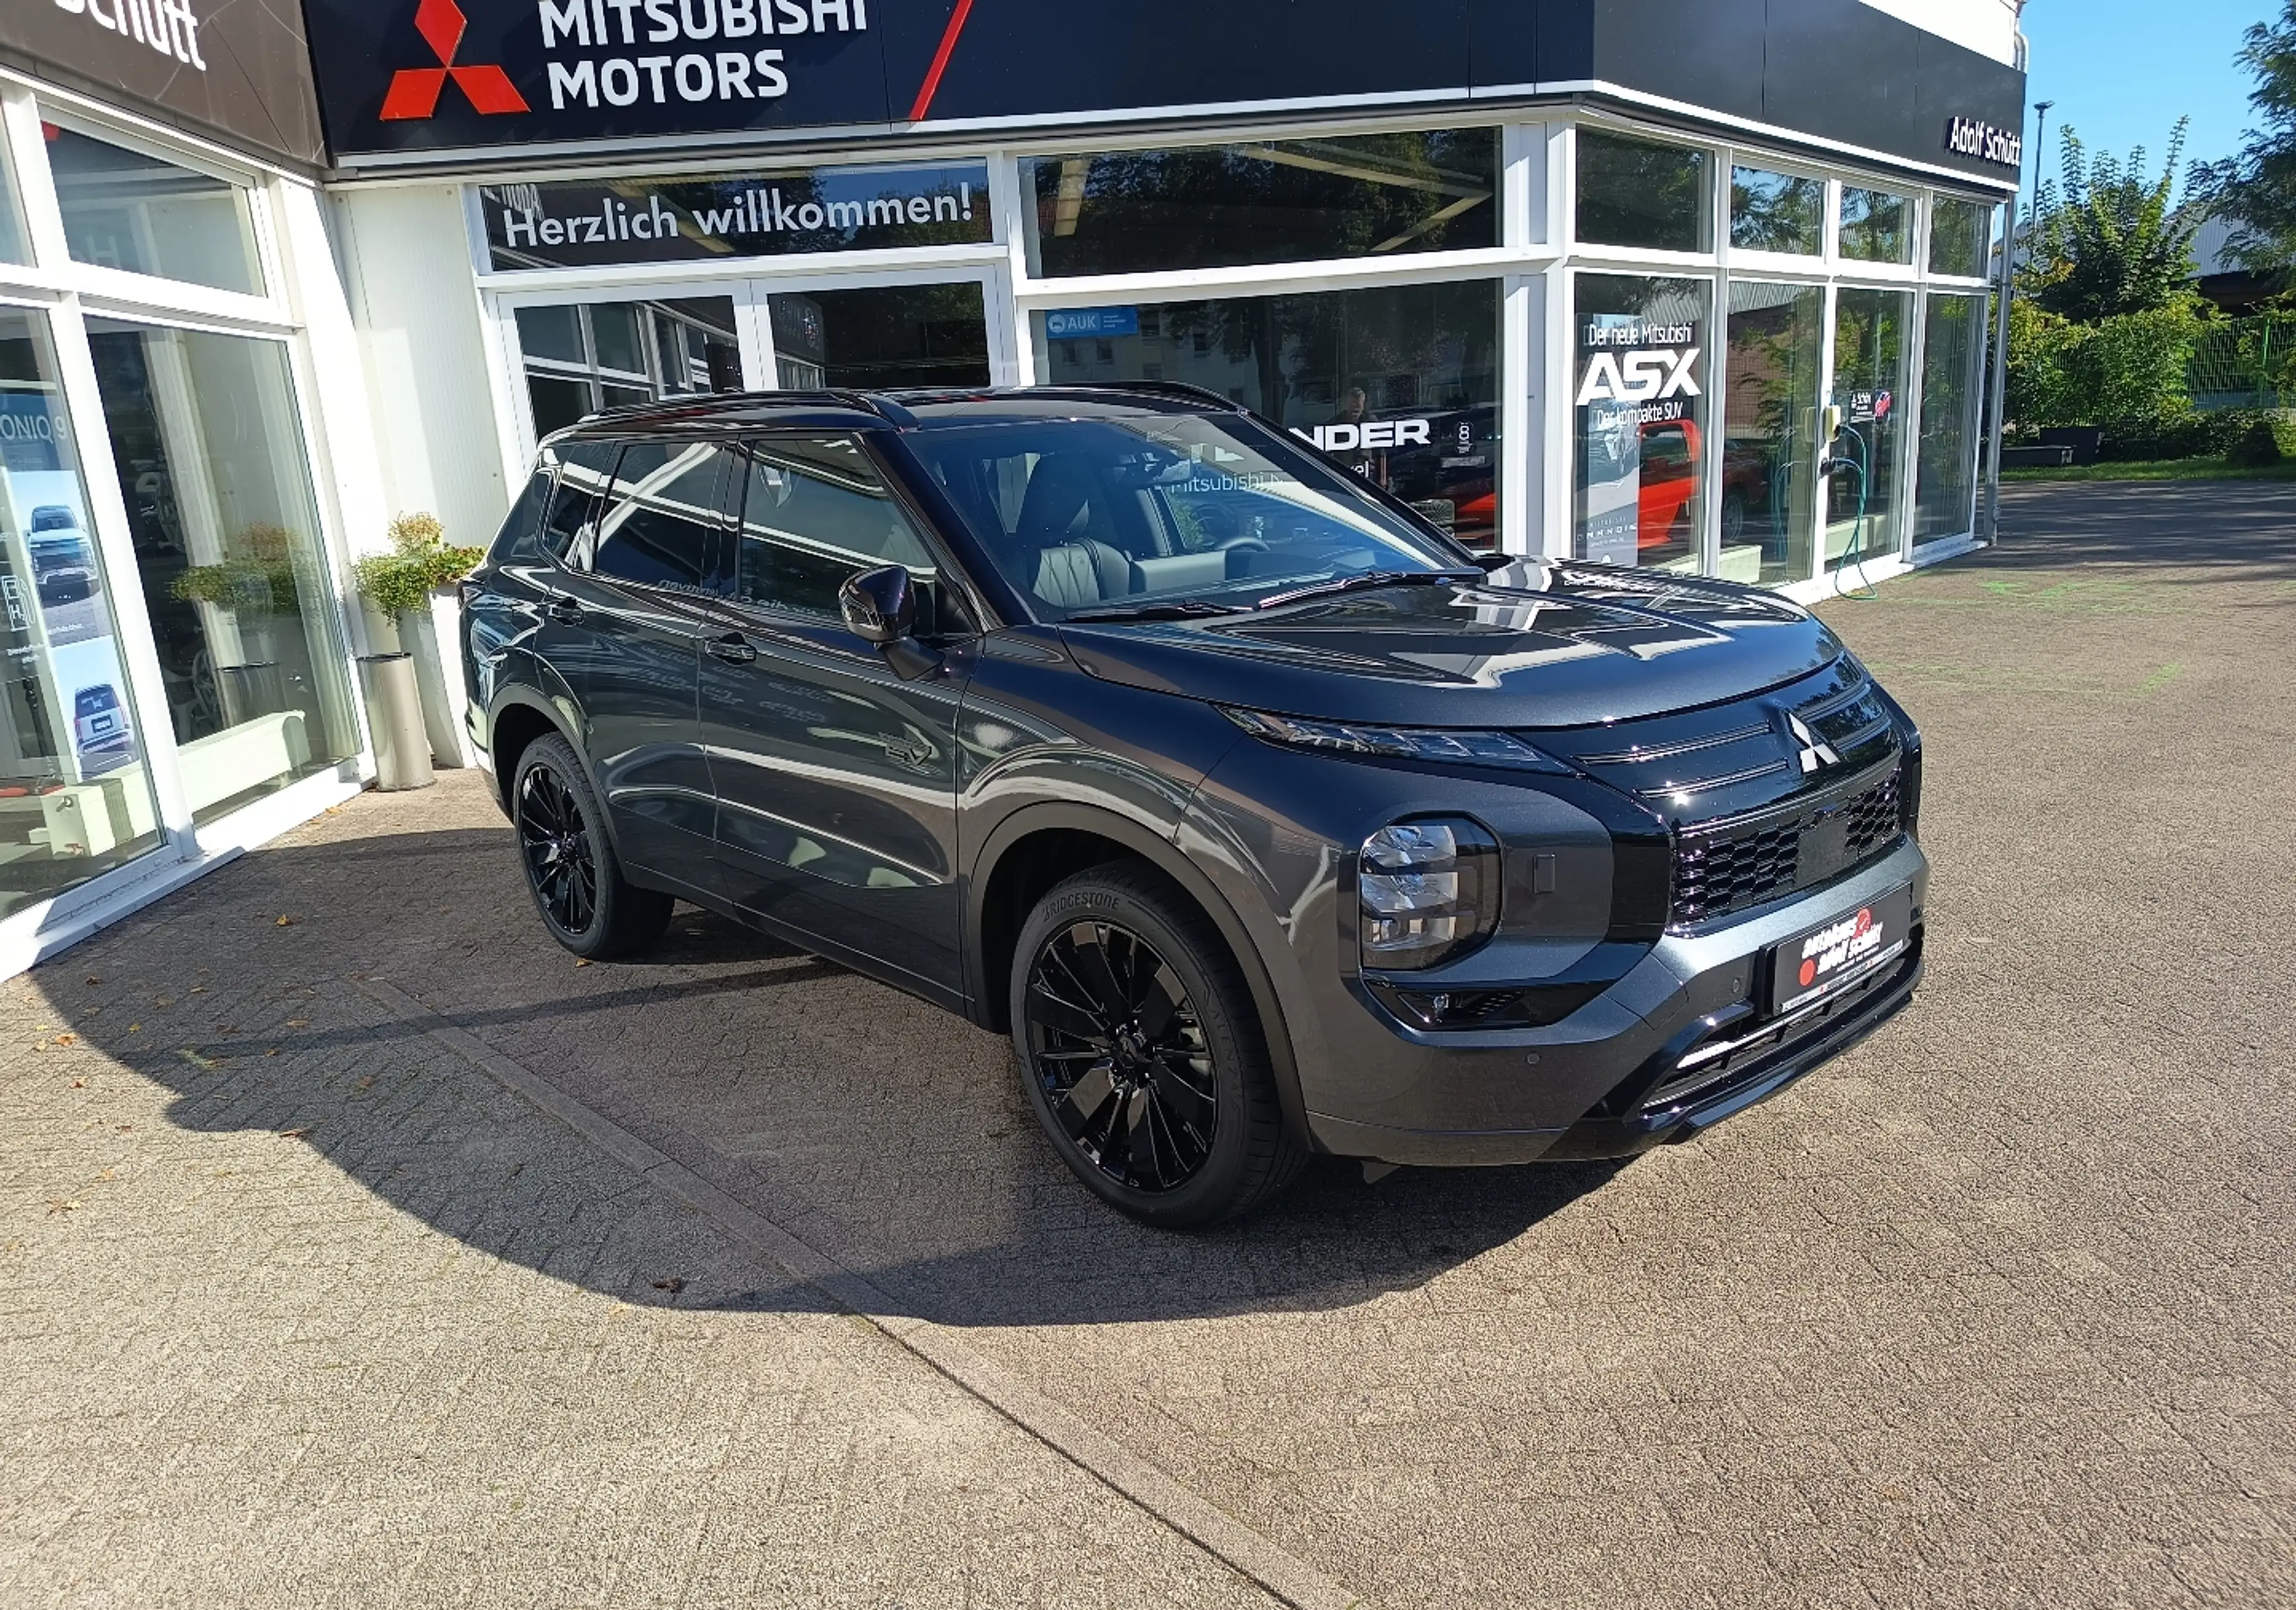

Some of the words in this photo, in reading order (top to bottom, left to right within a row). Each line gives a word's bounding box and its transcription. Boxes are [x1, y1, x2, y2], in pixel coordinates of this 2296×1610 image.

[539, 0, 868, 48] MITSUBISHI
[546, 49, 789, 109] MOTORS
[1950, 115, 1984, 156] Adolf
[503, 196, 678, 248] Herzlich
[694, 181, 973, 236] willkommen!
[1068, 315, 1097, 329] AUK
[1589, 323, 1607, 346] Der
[1612, 326, 1638, 346] neue
[1642, 322, 1693, 344] Mitsubishi
[1575, 347, 1703, 406] ASX
[0, 414, 54, 445] ONIQ
[1597, 409, 1614, 428] Der
[1616, 403, 1663, 426] kompakte
[1664, 401, 1683, 420] SUV
[1042, 891, 1120, 922] BRIDGESTONE
